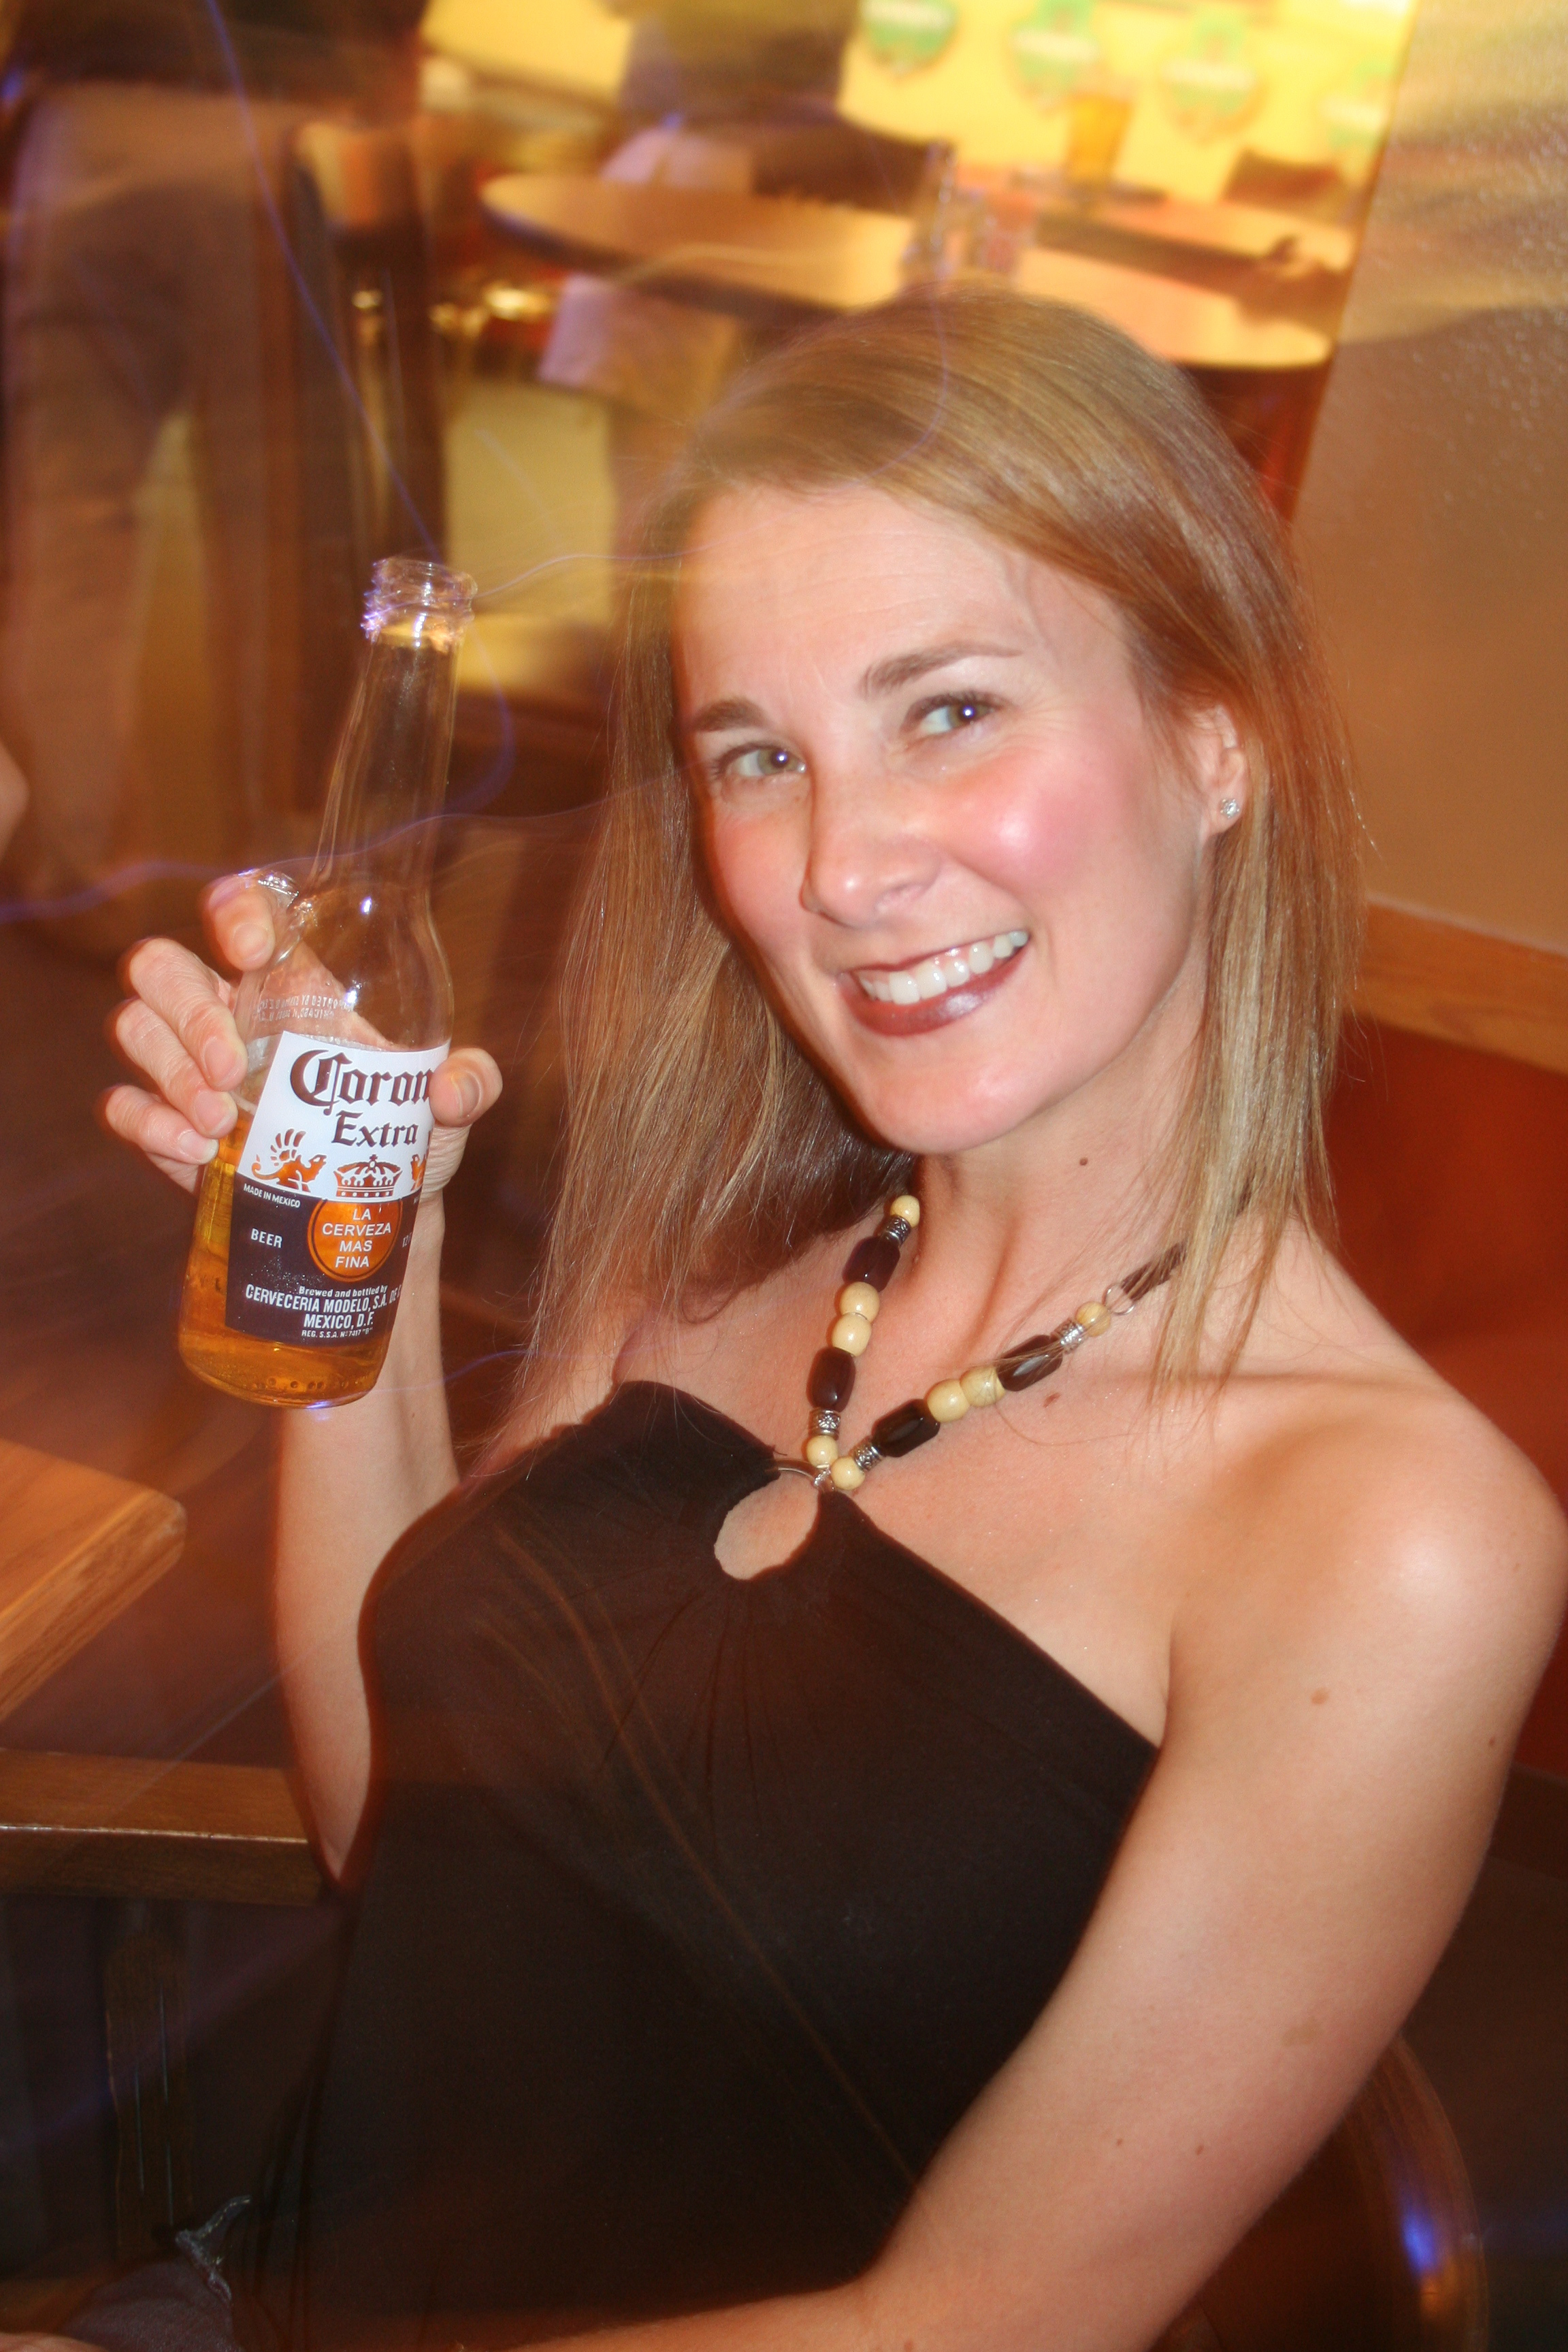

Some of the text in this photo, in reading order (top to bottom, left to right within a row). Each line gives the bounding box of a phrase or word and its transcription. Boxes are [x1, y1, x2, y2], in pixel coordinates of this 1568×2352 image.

[290, 1049, 434, 1115] Coron
[331, 1110, 418, 1147] Extra
[243, 1183, 301, 1209] MADE IN MEXICO
[353, 1208, 372, 1221] LA
[322, 1222, 392, 1237] CERVEZA
[250, 1228, 283, 1249] BEER
[339, 1240, 373, 1253] MAS
[335, 1256, 370, 1269] FINA
[245, 1284, 320, 1313] CERVECERIA
[323, 1297, 371, 1313] MODELO,
[372, 1293, 387, 1309] S.A.
[299, 1286, 333, 1297] Brewed
[334, 1289, 351, 1298] and
[353, 1286, 379, 1297] bottled
[380, 1284, 389, 1294] by
[304, 1311, 374, 1330] MEXICO, D.F.
[301, 1329, 317, 1338] REG.
